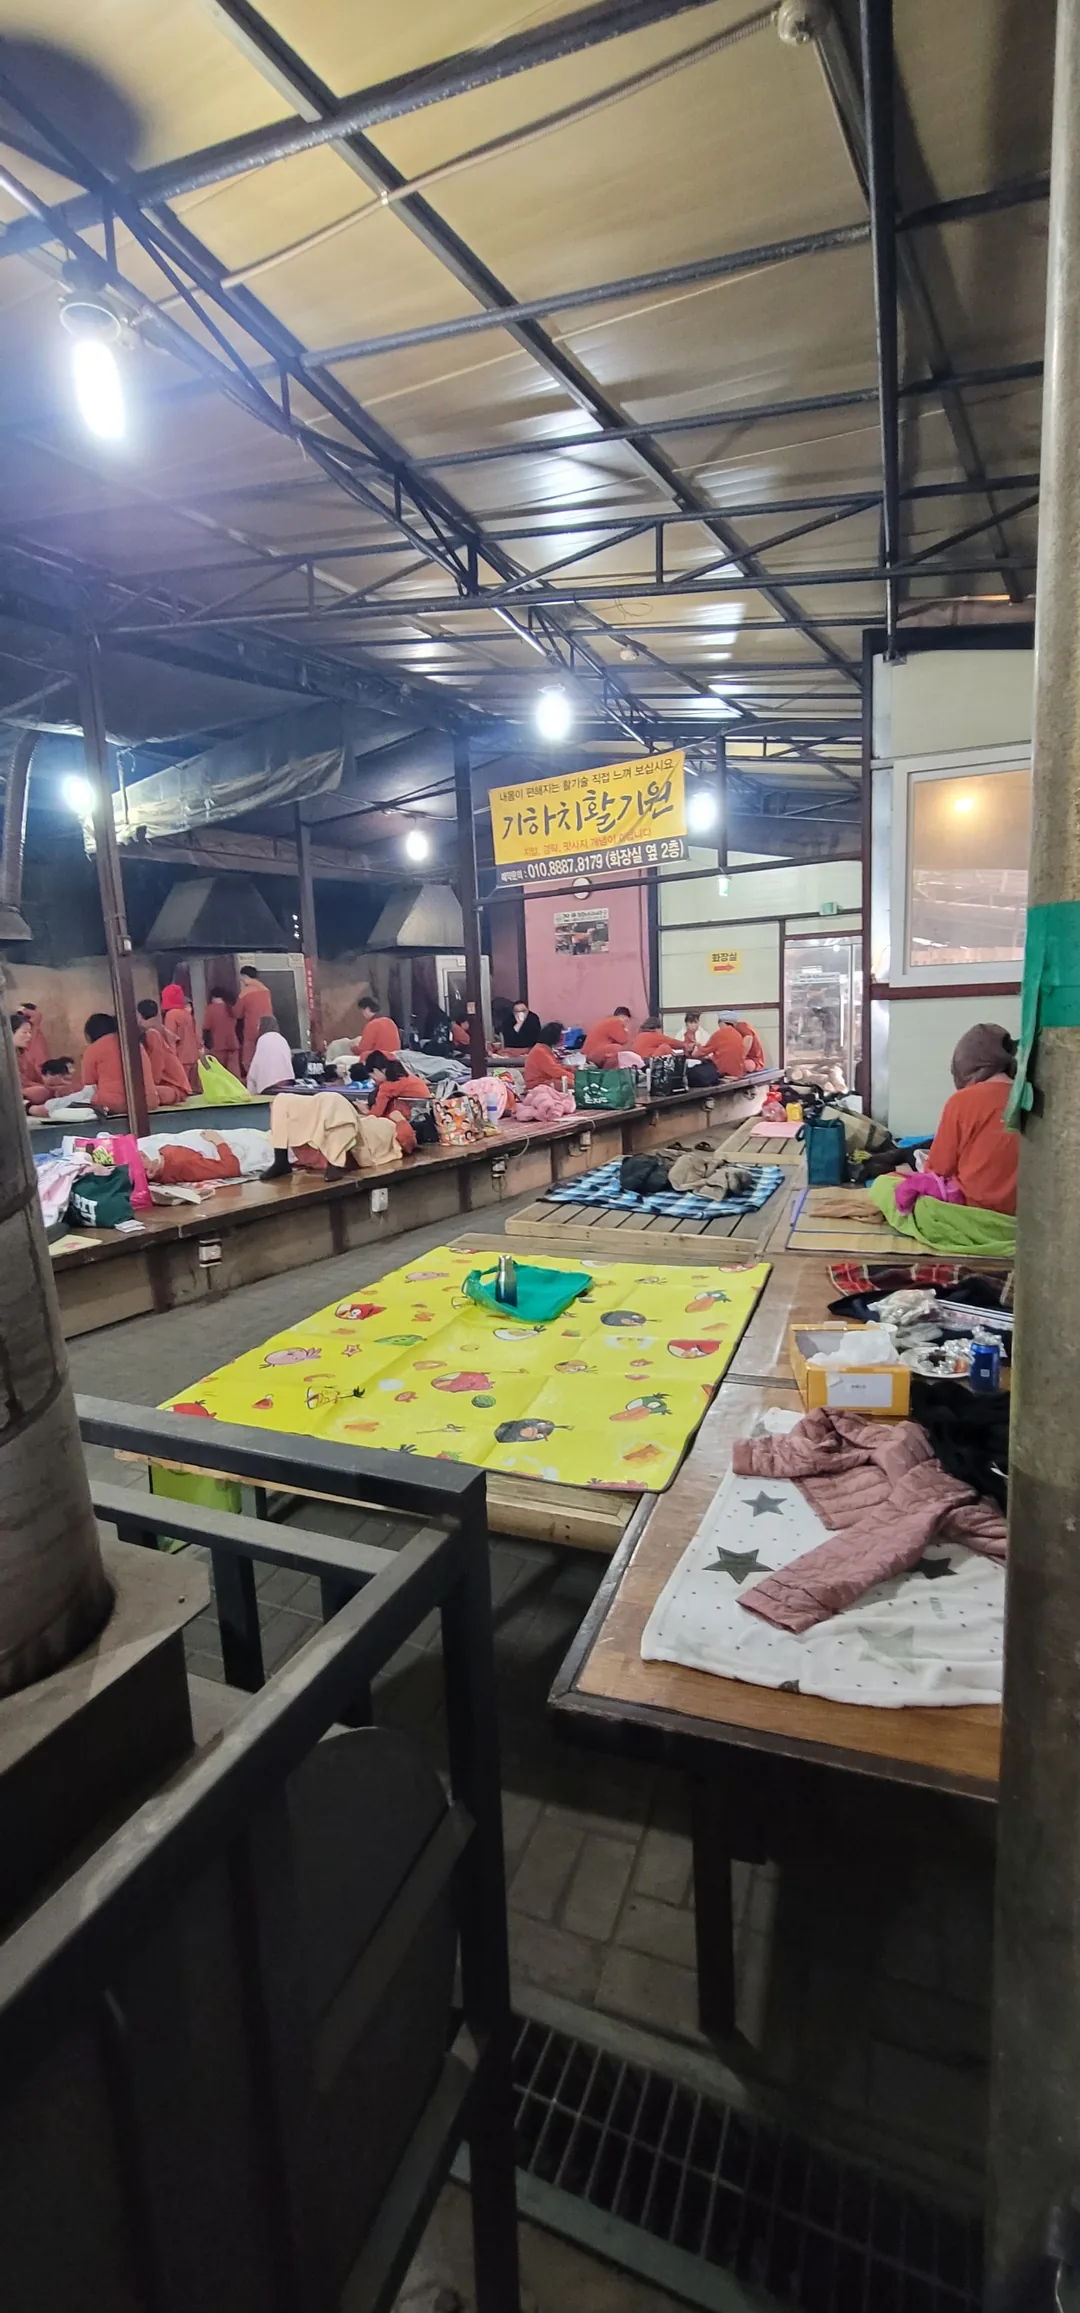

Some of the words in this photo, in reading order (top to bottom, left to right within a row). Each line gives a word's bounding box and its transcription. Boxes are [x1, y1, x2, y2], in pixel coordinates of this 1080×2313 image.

[592, 772, 609, 784] 직접
[613, 767, 631, 780] 느껴
[634, 758, 673, 776] 보십시요
[503, 781, 673, 839] 기하치활기원
[528, 853, 603, 878] 010.8887.8179
[606, 846, 643, 869] (화장실
[645, 843, 658, 862] 옆
[661, 839, 684, 858] 2층)
[712, 952, 737, 962] 화장실
